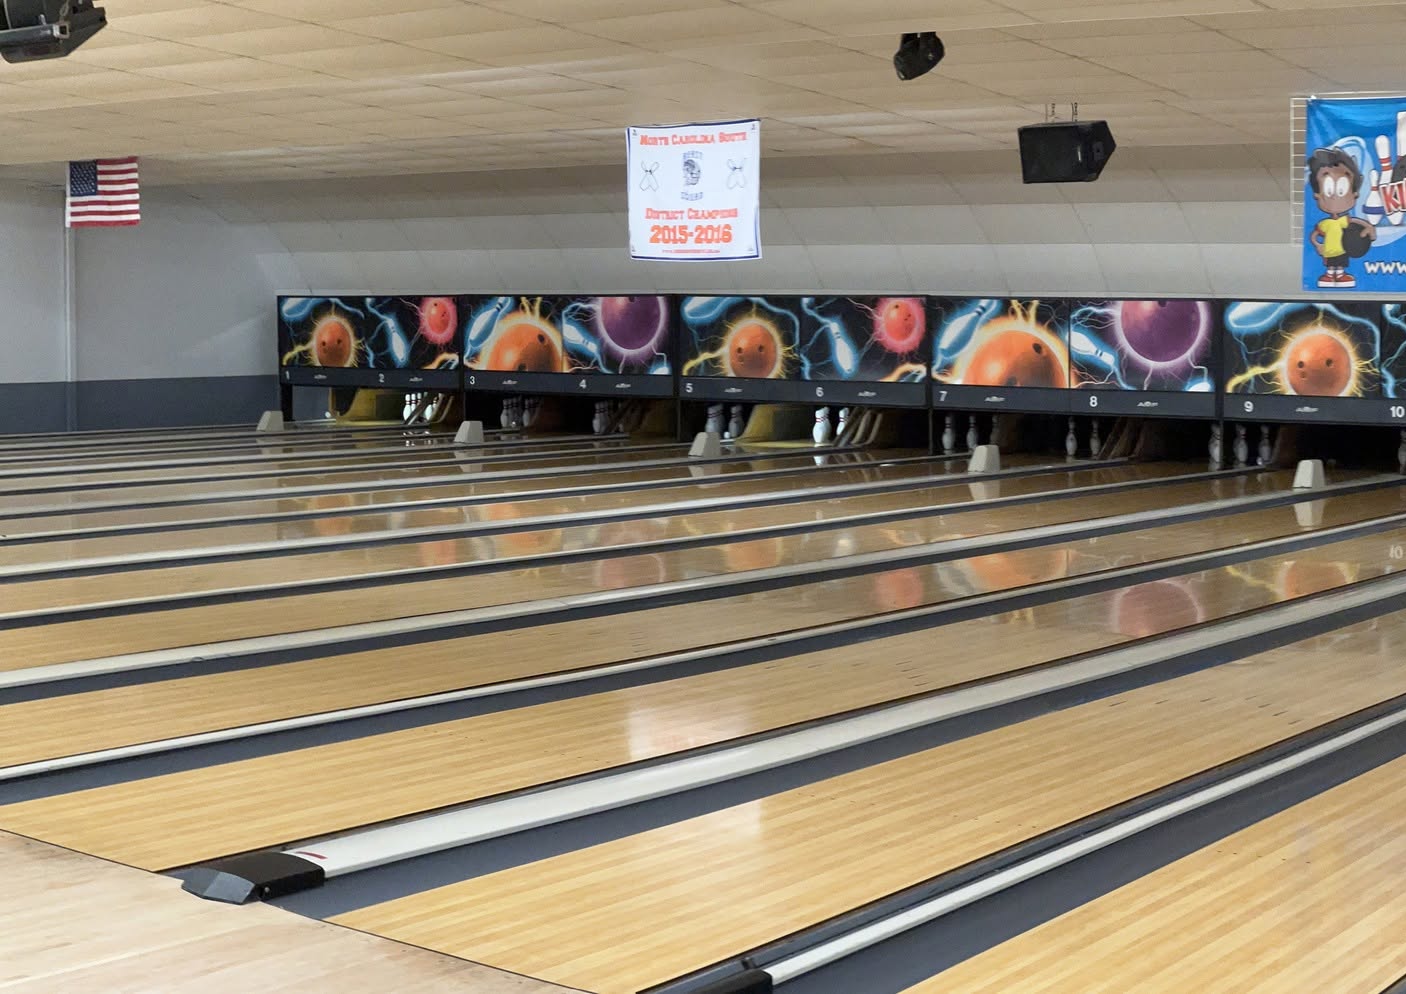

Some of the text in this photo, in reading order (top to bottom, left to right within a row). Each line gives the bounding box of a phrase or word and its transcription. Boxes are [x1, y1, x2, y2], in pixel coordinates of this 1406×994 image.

[649, 224, 732, 244] 2015-2016
[378, 373, 385, 383] 2
[469, 375, 476, 385] 3
[579, 379, 587, 389] 4
[685, 382, 693, 393] 5
[815, 386, 824, 398] 6
[939, 390, 948, 402] 7
[1089, 395, 1098, 408] 8
[1244, 400, 1254, 413] 9
[1389, 405, 1405, 418] 10
